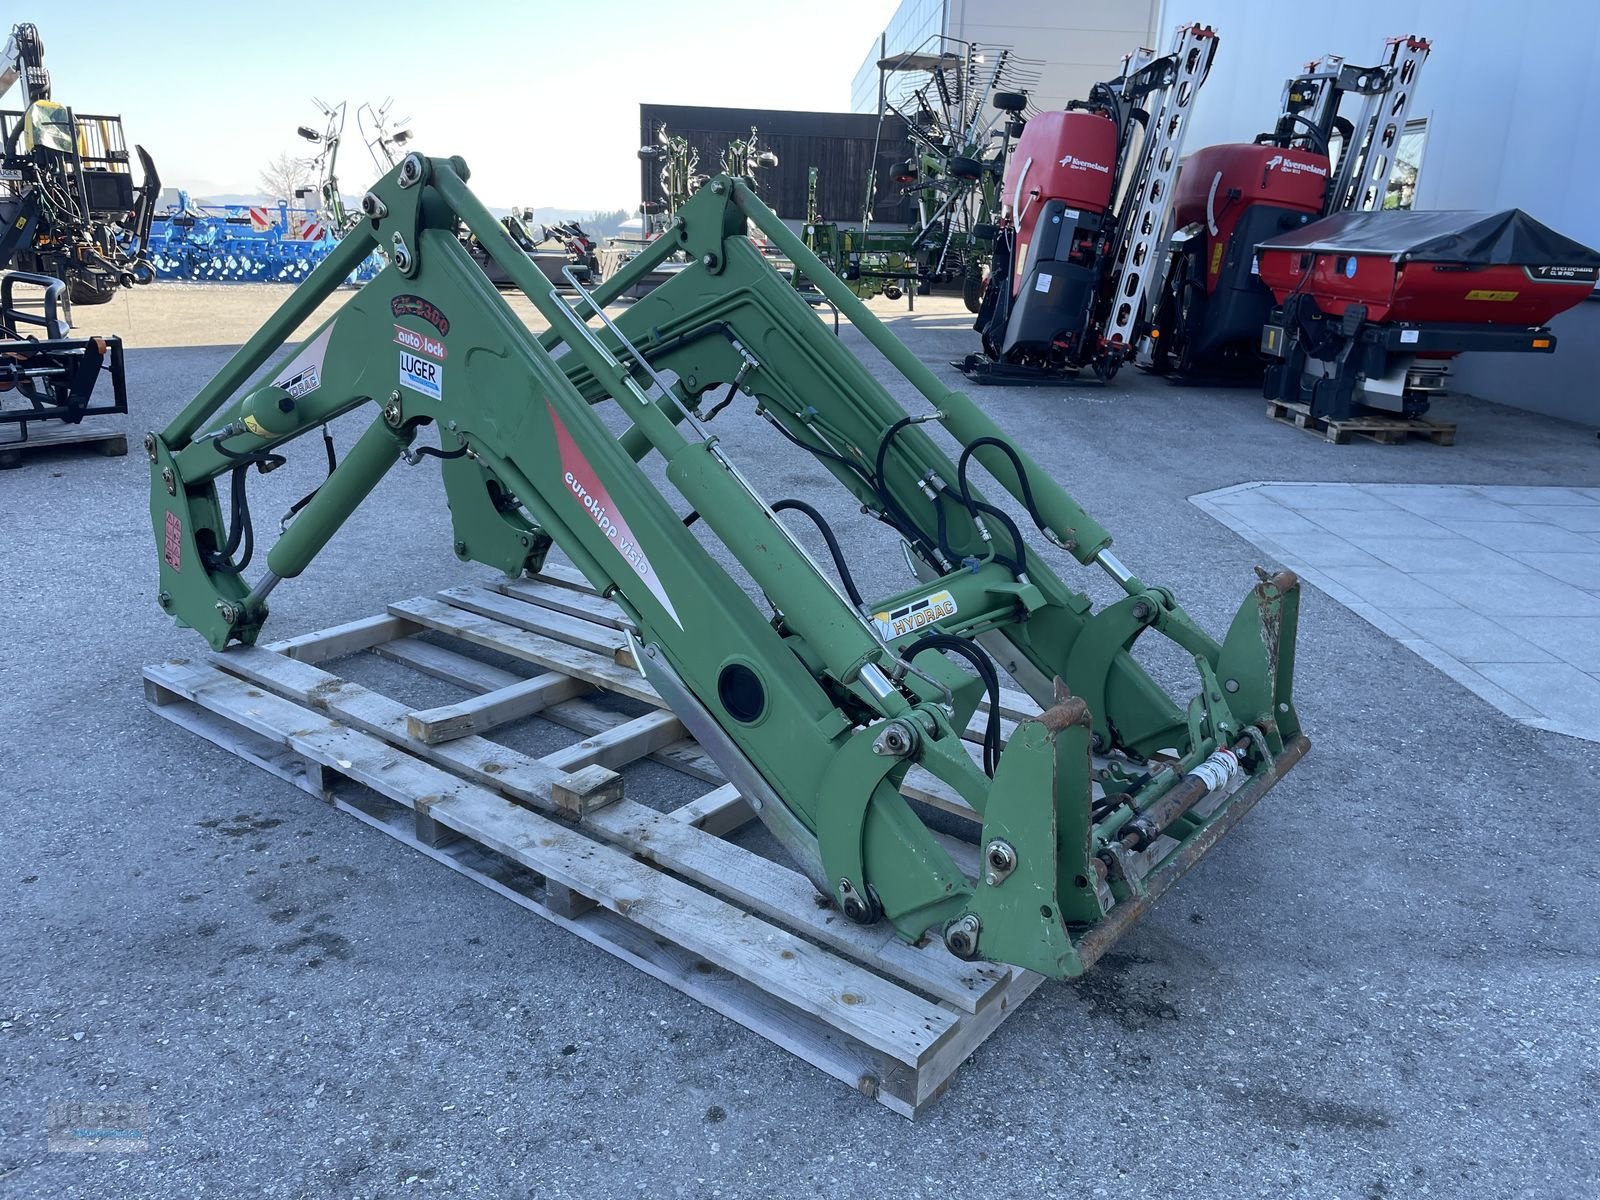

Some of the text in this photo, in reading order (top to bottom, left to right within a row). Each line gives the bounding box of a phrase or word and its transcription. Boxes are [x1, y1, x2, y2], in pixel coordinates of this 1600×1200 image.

[1071, 157, 1109, 174] Kverneland
[1282, 158, 1327, 176] Kverneland
[398, 330, 444, 358] auto lock
[401, 354, 436, 383] LUGER
[564, 471, 649, 575] eurokipp visio
[892, 600, 954, 636] HYDRAC
